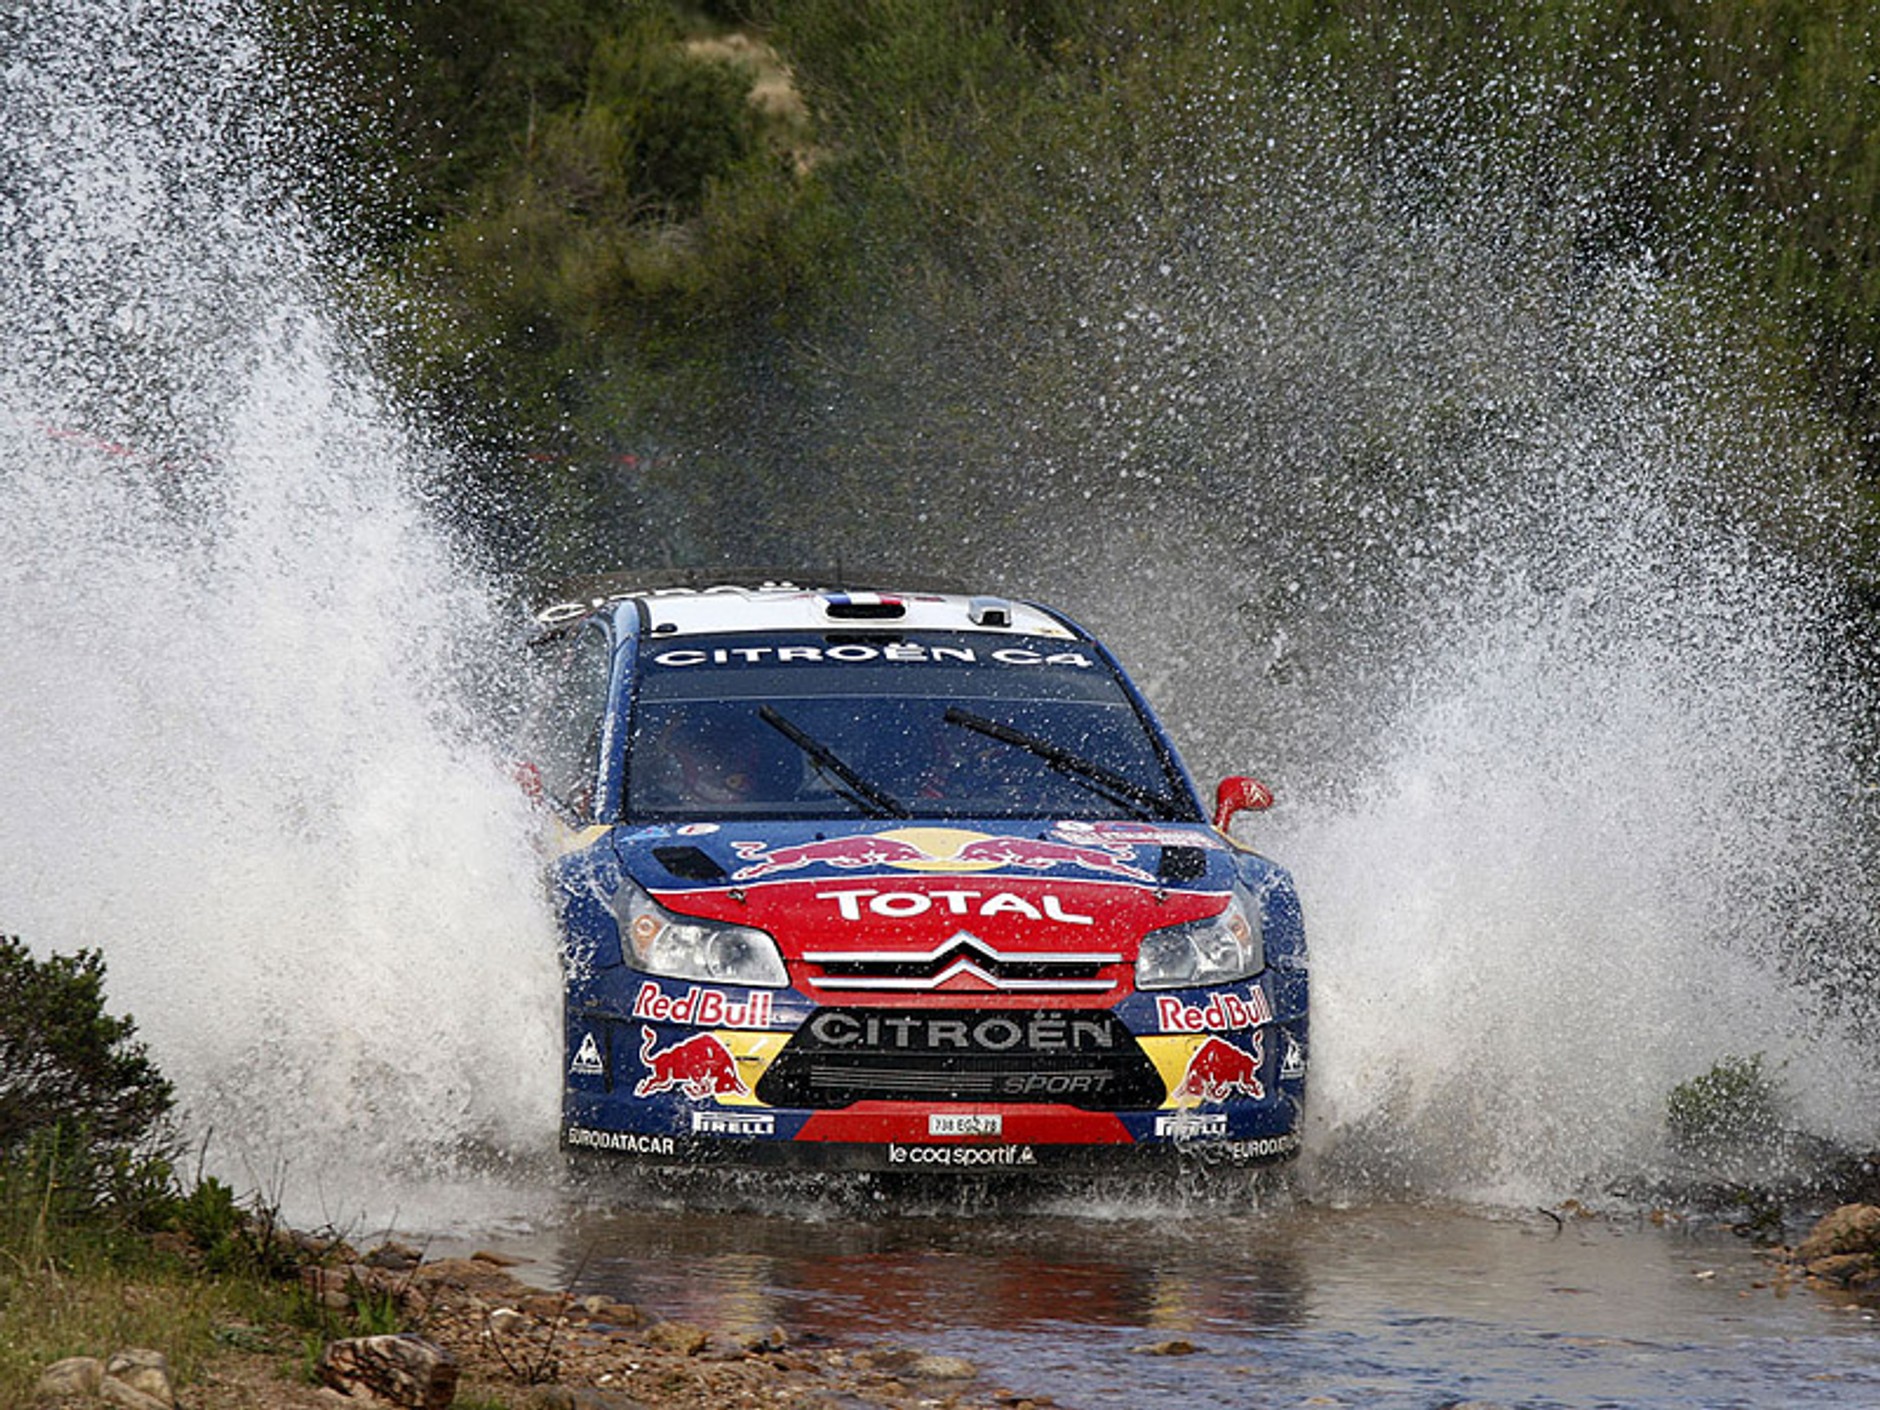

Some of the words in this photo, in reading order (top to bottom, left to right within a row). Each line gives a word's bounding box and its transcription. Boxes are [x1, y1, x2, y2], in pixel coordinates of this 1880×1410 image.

[654, 643, 976, 666] CITROËN
[992, 649, 1094, 668] C4
[816, 889, 1094, 925] TOTAL
[633, 982, 699, 1023] Red
[697, 990, 774, 1027] Bull
[1156, 992, 1226, 1032] Red
[1223, 984, 1272, 1031] Bull
[810, 1012, 1114, 1050] CITROËN
[1003, 1072, 1113, 1094] SPORT
[692, 1112, 774, 1134] PIRELLI
[1155, 1114, 1227, 1136] PILLI
[889, 1143, 907, 1163] le
[910, 1148, 950, 1165] coq
[953, 1144, 1016, 1166] sportif
